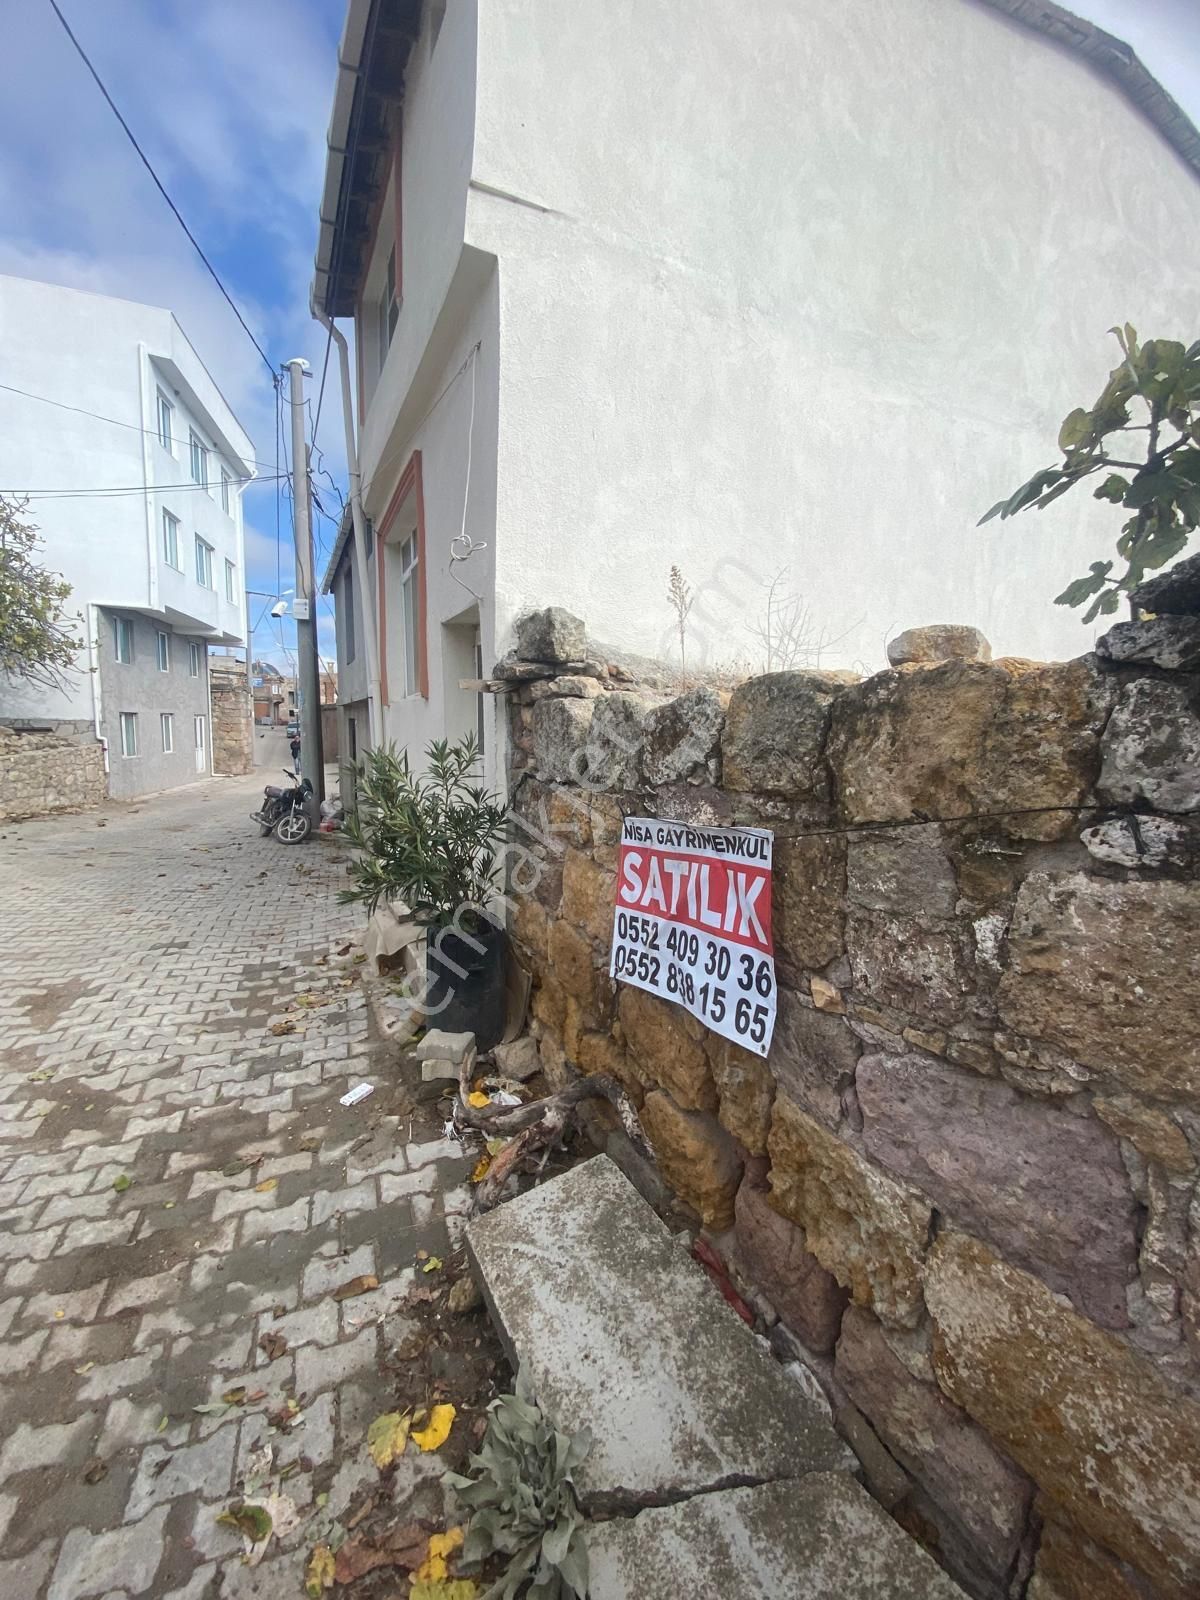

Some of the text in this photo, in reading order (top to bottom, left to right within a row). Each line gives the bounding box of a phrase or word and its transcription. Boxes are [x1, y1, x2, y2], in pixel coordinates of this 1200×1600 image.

[624, 821, 653, 842] NİSA
[620, 851, 768, 946] SATILIK
[614, 944, 769, 1044] 0552 838 15 65
[617, 912, 772, 998] 0552 409 30 36
